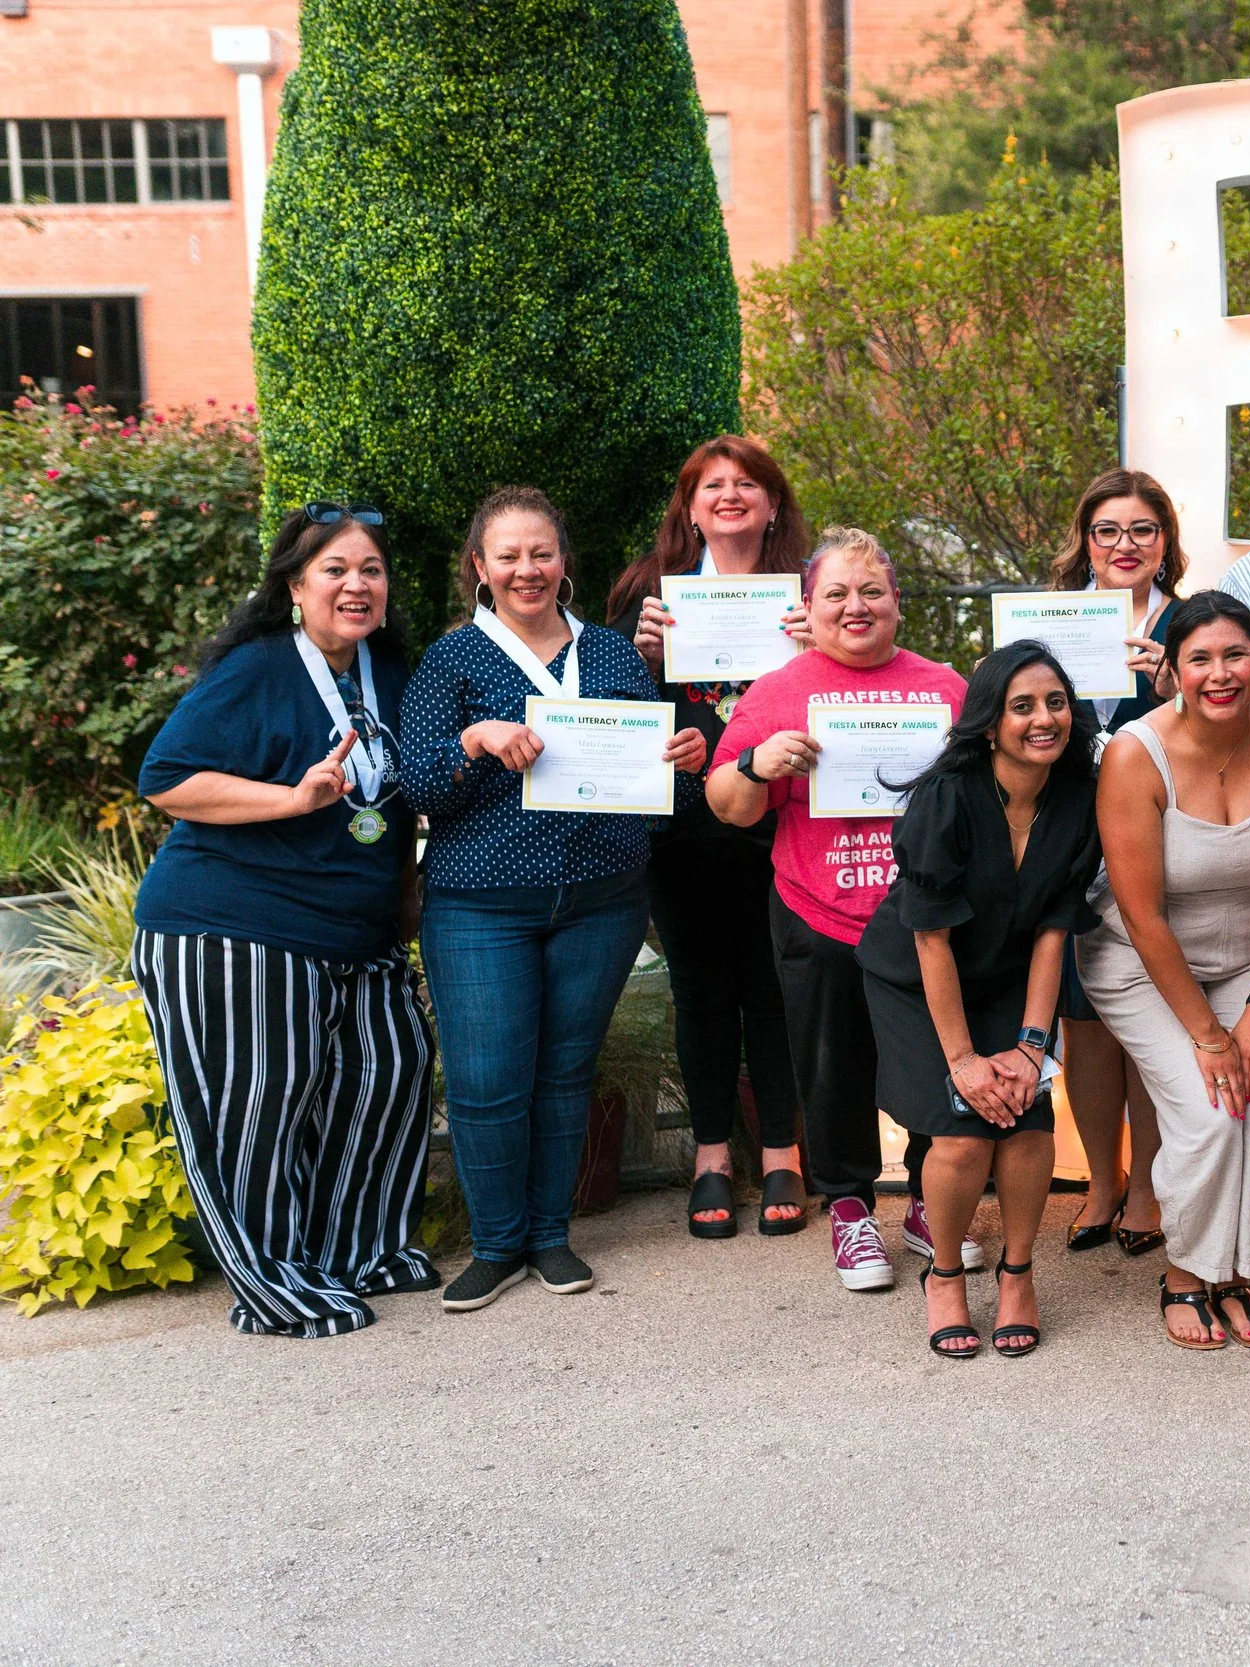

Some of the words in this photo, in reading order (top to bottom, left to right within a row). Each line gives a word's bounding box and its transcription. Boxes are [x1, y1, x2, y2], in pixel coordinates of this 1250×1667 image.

[681, 592, 707, 600] FIESTA
[710, 591, 747, 599] LITERACY
[751, 590, 786, 599] AWARDS
[1012, 610, 1037, 618] FIESTA
[1041, 608, 1078, 617] LITERACY
[1082, 607, 1118, 616] AWARDS
[808, 691, 903, 704] GIRAFFES
[907, 691, 942, 703] ARE
[546, 715, 574, 723] FIESTA
[578, 716, 617, 725] LITERACY
[621, 718, 659, 727] AWARDS
[829, 721, 856, 729] FIESTA
[860, 721, 898, 729] LITERACY
[902, 721, 938, 729] AWARDS
[833, 836, 837, 848] I
[839, 834, 864, 848] AM
